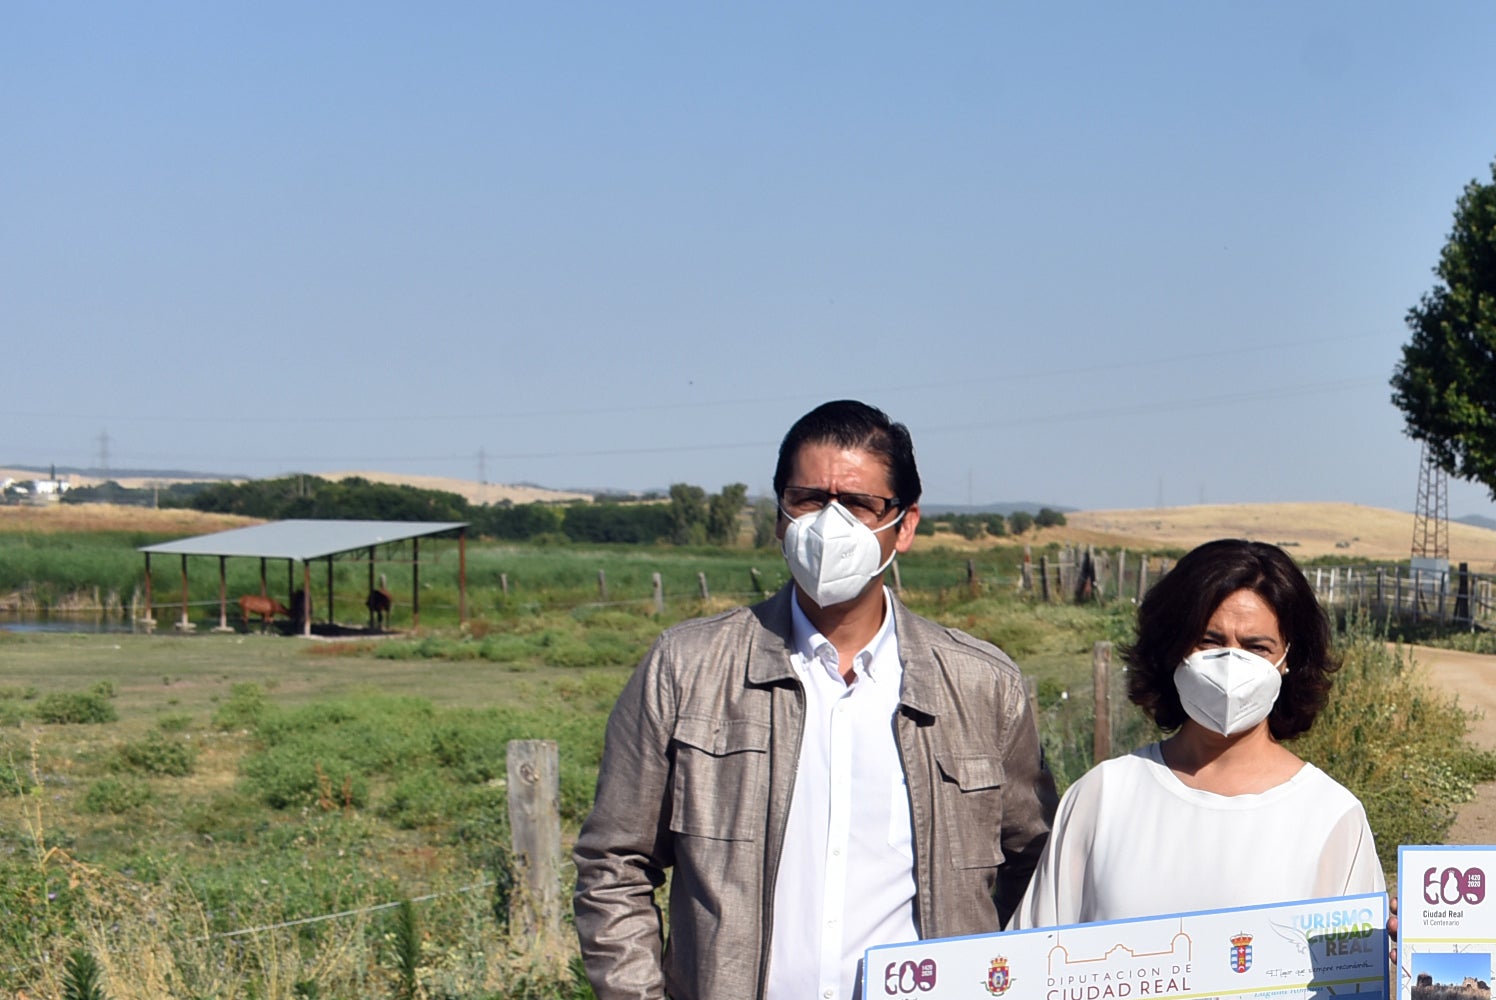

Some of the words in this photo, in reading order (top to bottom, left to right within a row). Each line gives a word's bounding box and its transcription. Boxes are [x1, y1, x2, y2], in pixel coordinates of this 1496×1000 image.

[1423, 910, 1447, 918] Ciudad
[1448, 910, 1463, 918] Real
[1306, 923, 1373, 944] CIUDAD
[1326, 939, 1373, 957] REAL
[1172, 964, 1192, 974] DE
[1141, 977, 1191, 995] REAL
